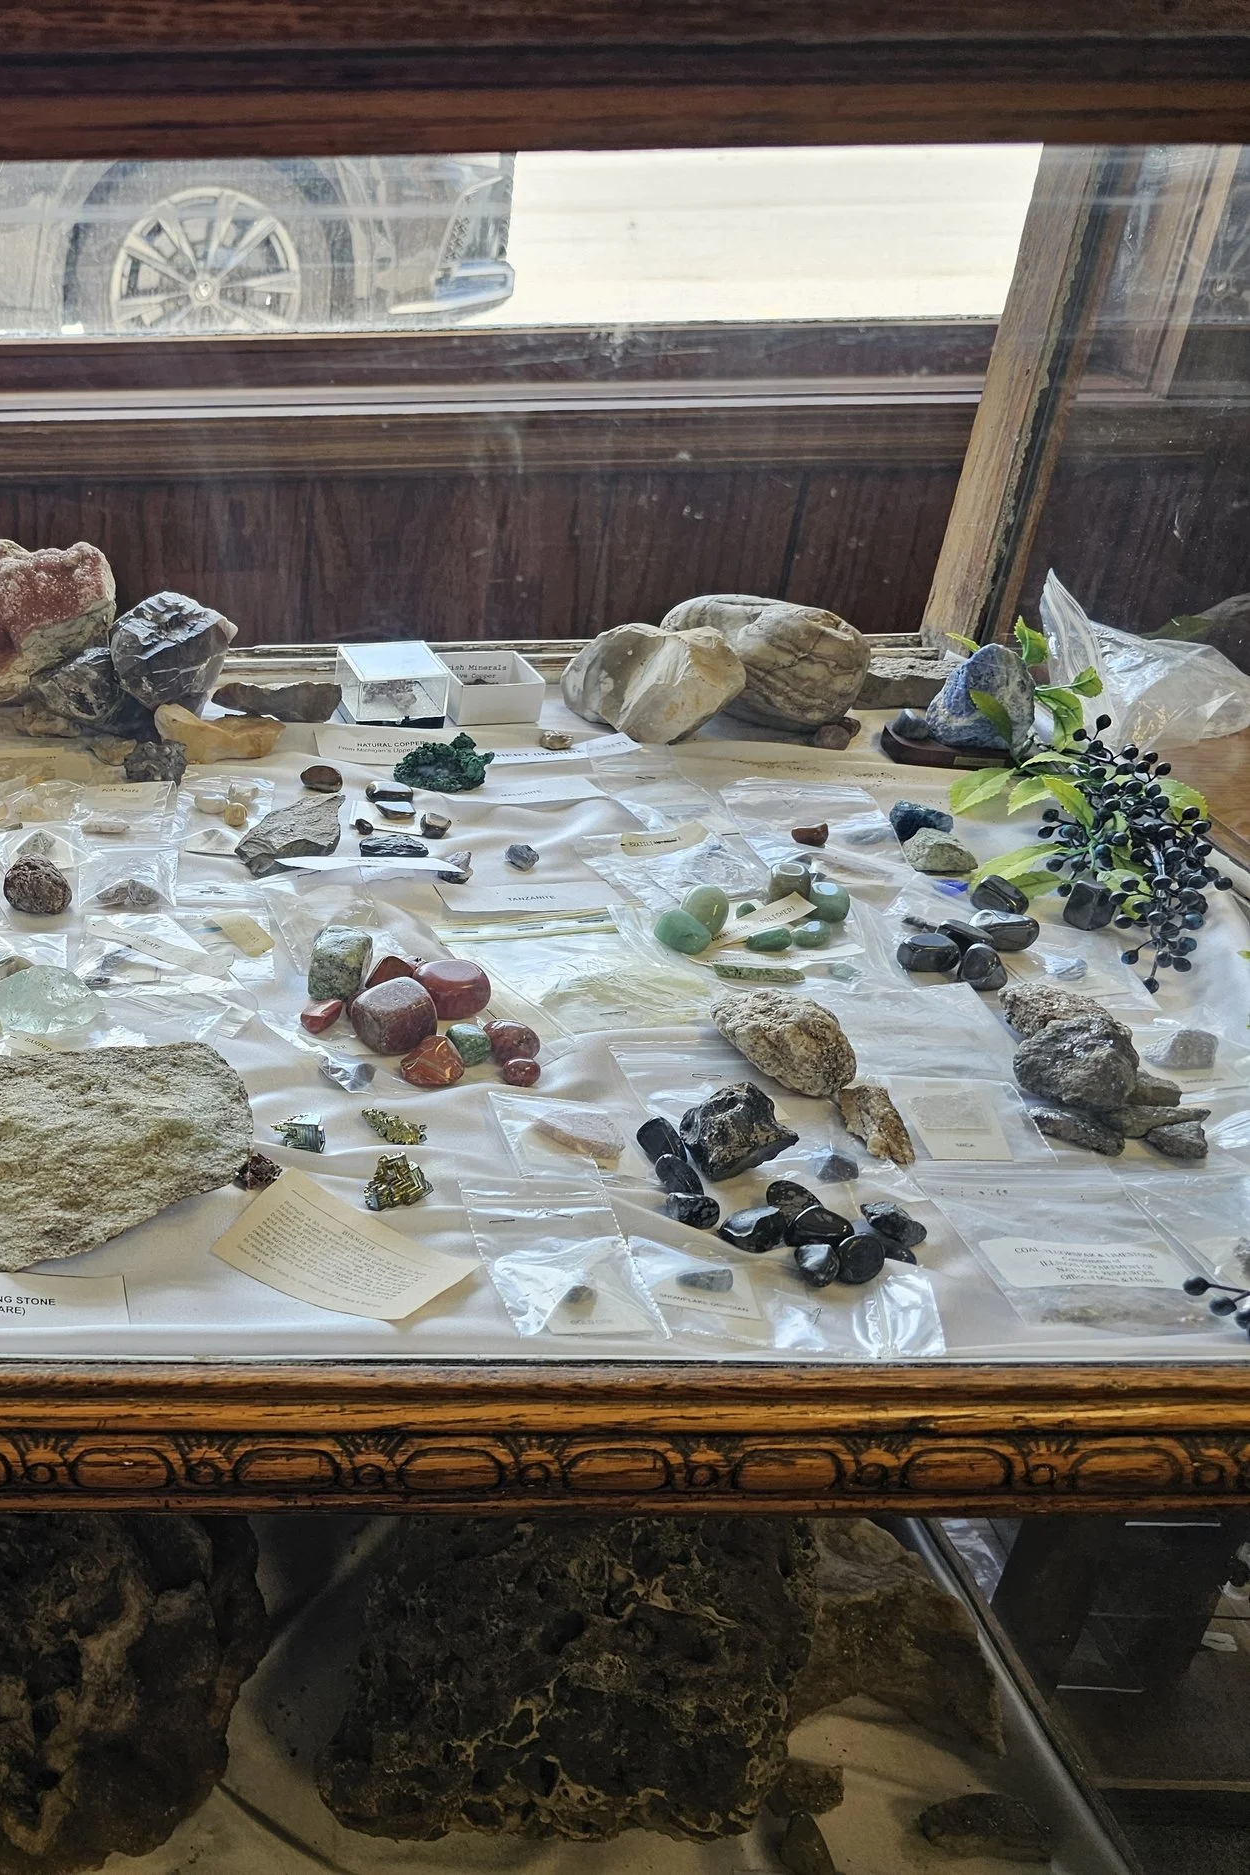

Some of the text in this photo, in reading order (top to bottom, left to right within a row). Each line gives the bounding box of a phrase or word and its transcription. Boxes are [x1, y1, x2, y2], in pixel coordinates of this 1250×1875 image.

[471, 673, 496, 681] Copper
[340, 1230, 376, 1251] BISMUTH
[16, 1296, 56, 1306] STONE
[659, 1292, 709, 1305] SNOWFLAKE
